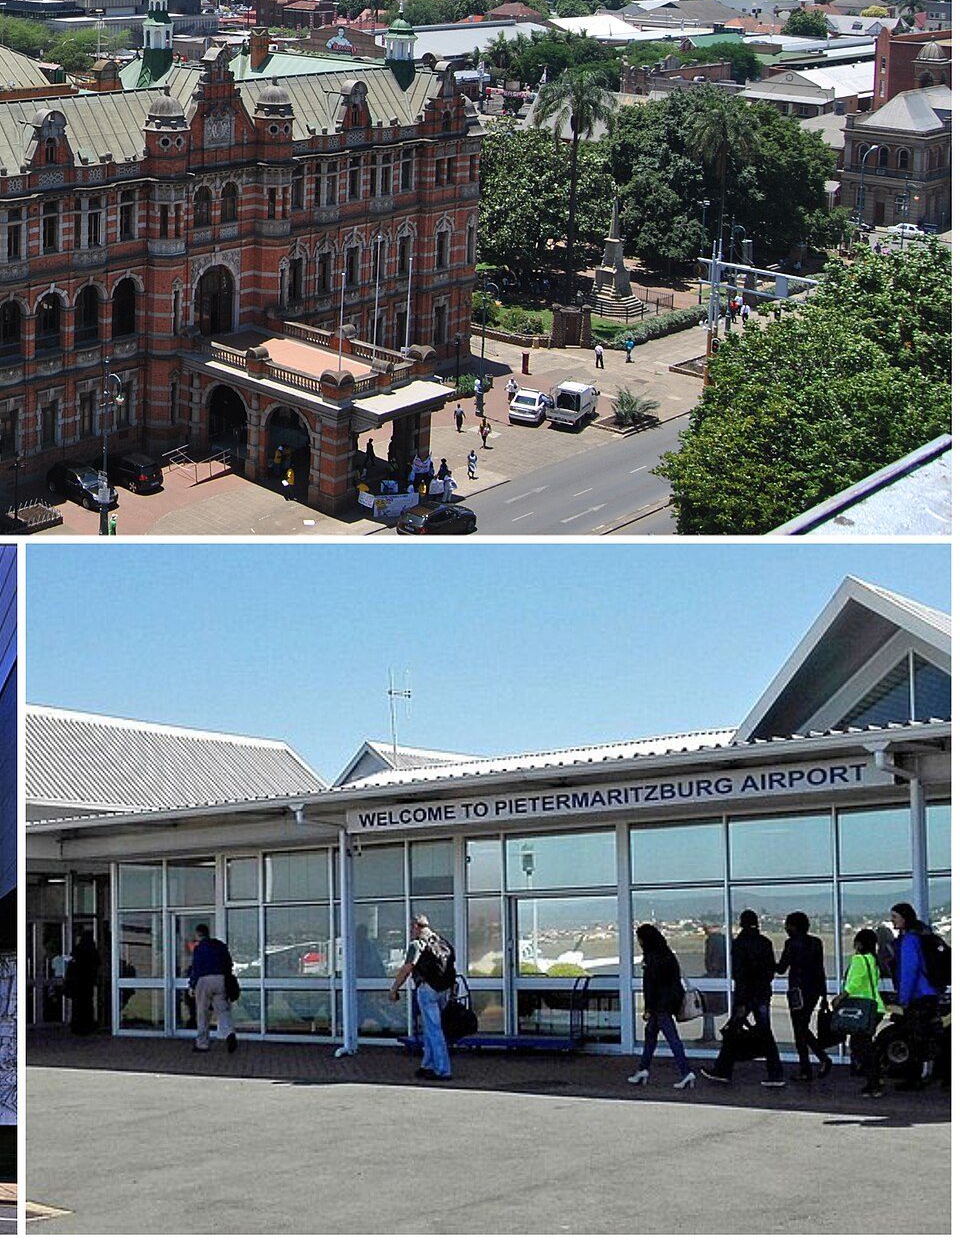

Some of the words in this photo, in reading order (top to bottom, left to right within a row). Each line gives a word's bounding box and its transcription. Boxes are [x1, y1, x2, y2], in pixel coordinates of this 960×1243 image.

[358, 805, 456, 827] WELCOME
[460, 802, 488, 818] TO
[495, 777, 733, 816] PIETERMARITZBURG
[740, 763, 867, 792] AIRPORT
